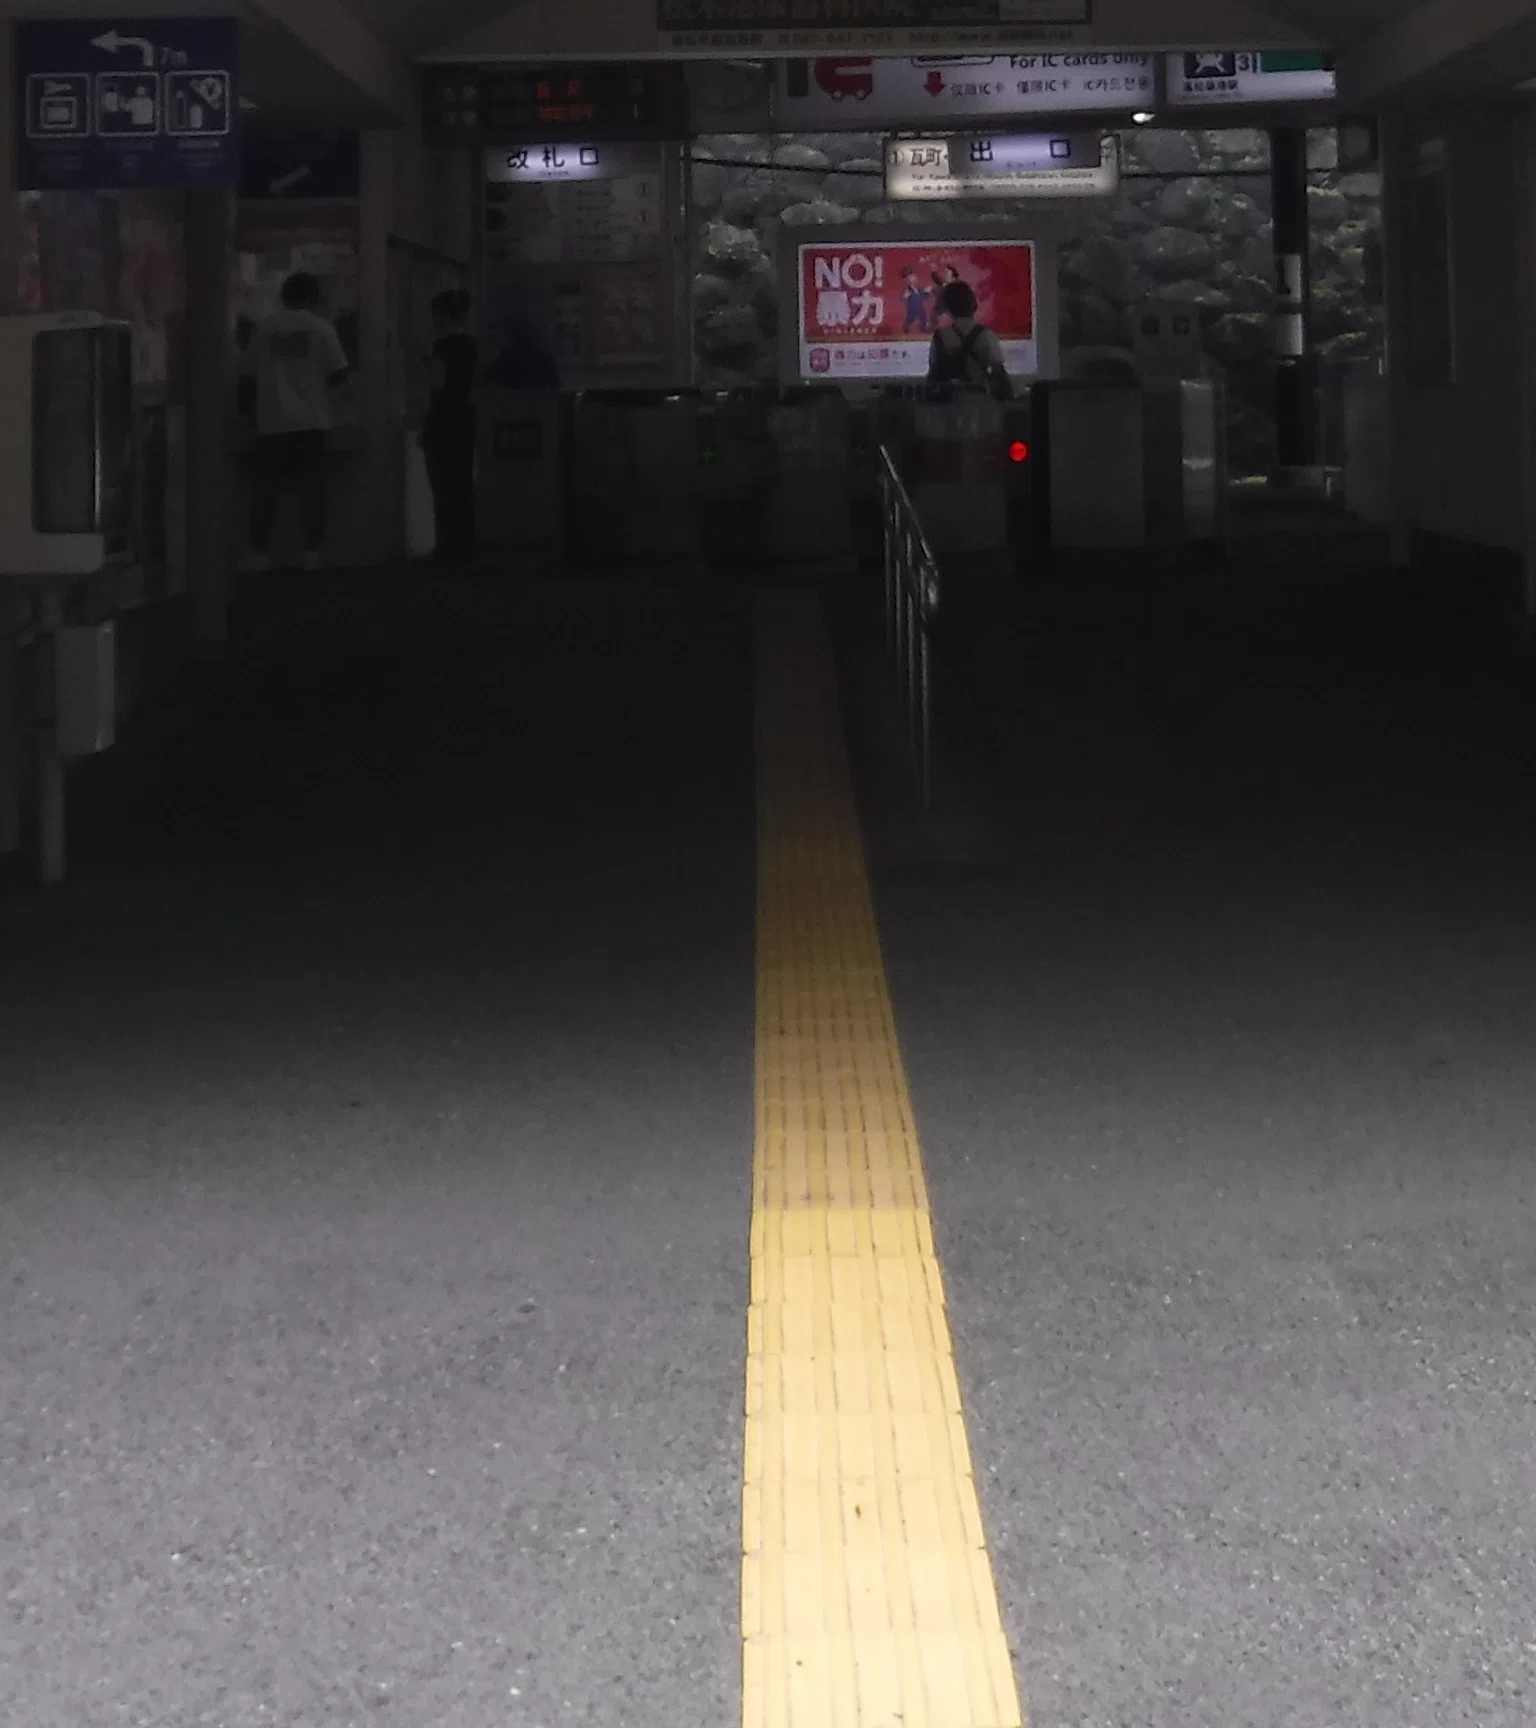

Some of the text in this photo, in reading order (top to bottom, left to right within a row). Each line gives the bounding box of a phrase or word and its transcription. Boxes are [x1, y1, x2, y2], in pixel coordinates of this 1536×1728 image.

[1042, 55, 1059, 68] IC
[506, 145, 599, 170] 改札口
[970, 139, 1071, 163] 出口
[814, 253, 884, 289] NO!
[816, 290, 884, 327] 暴力
